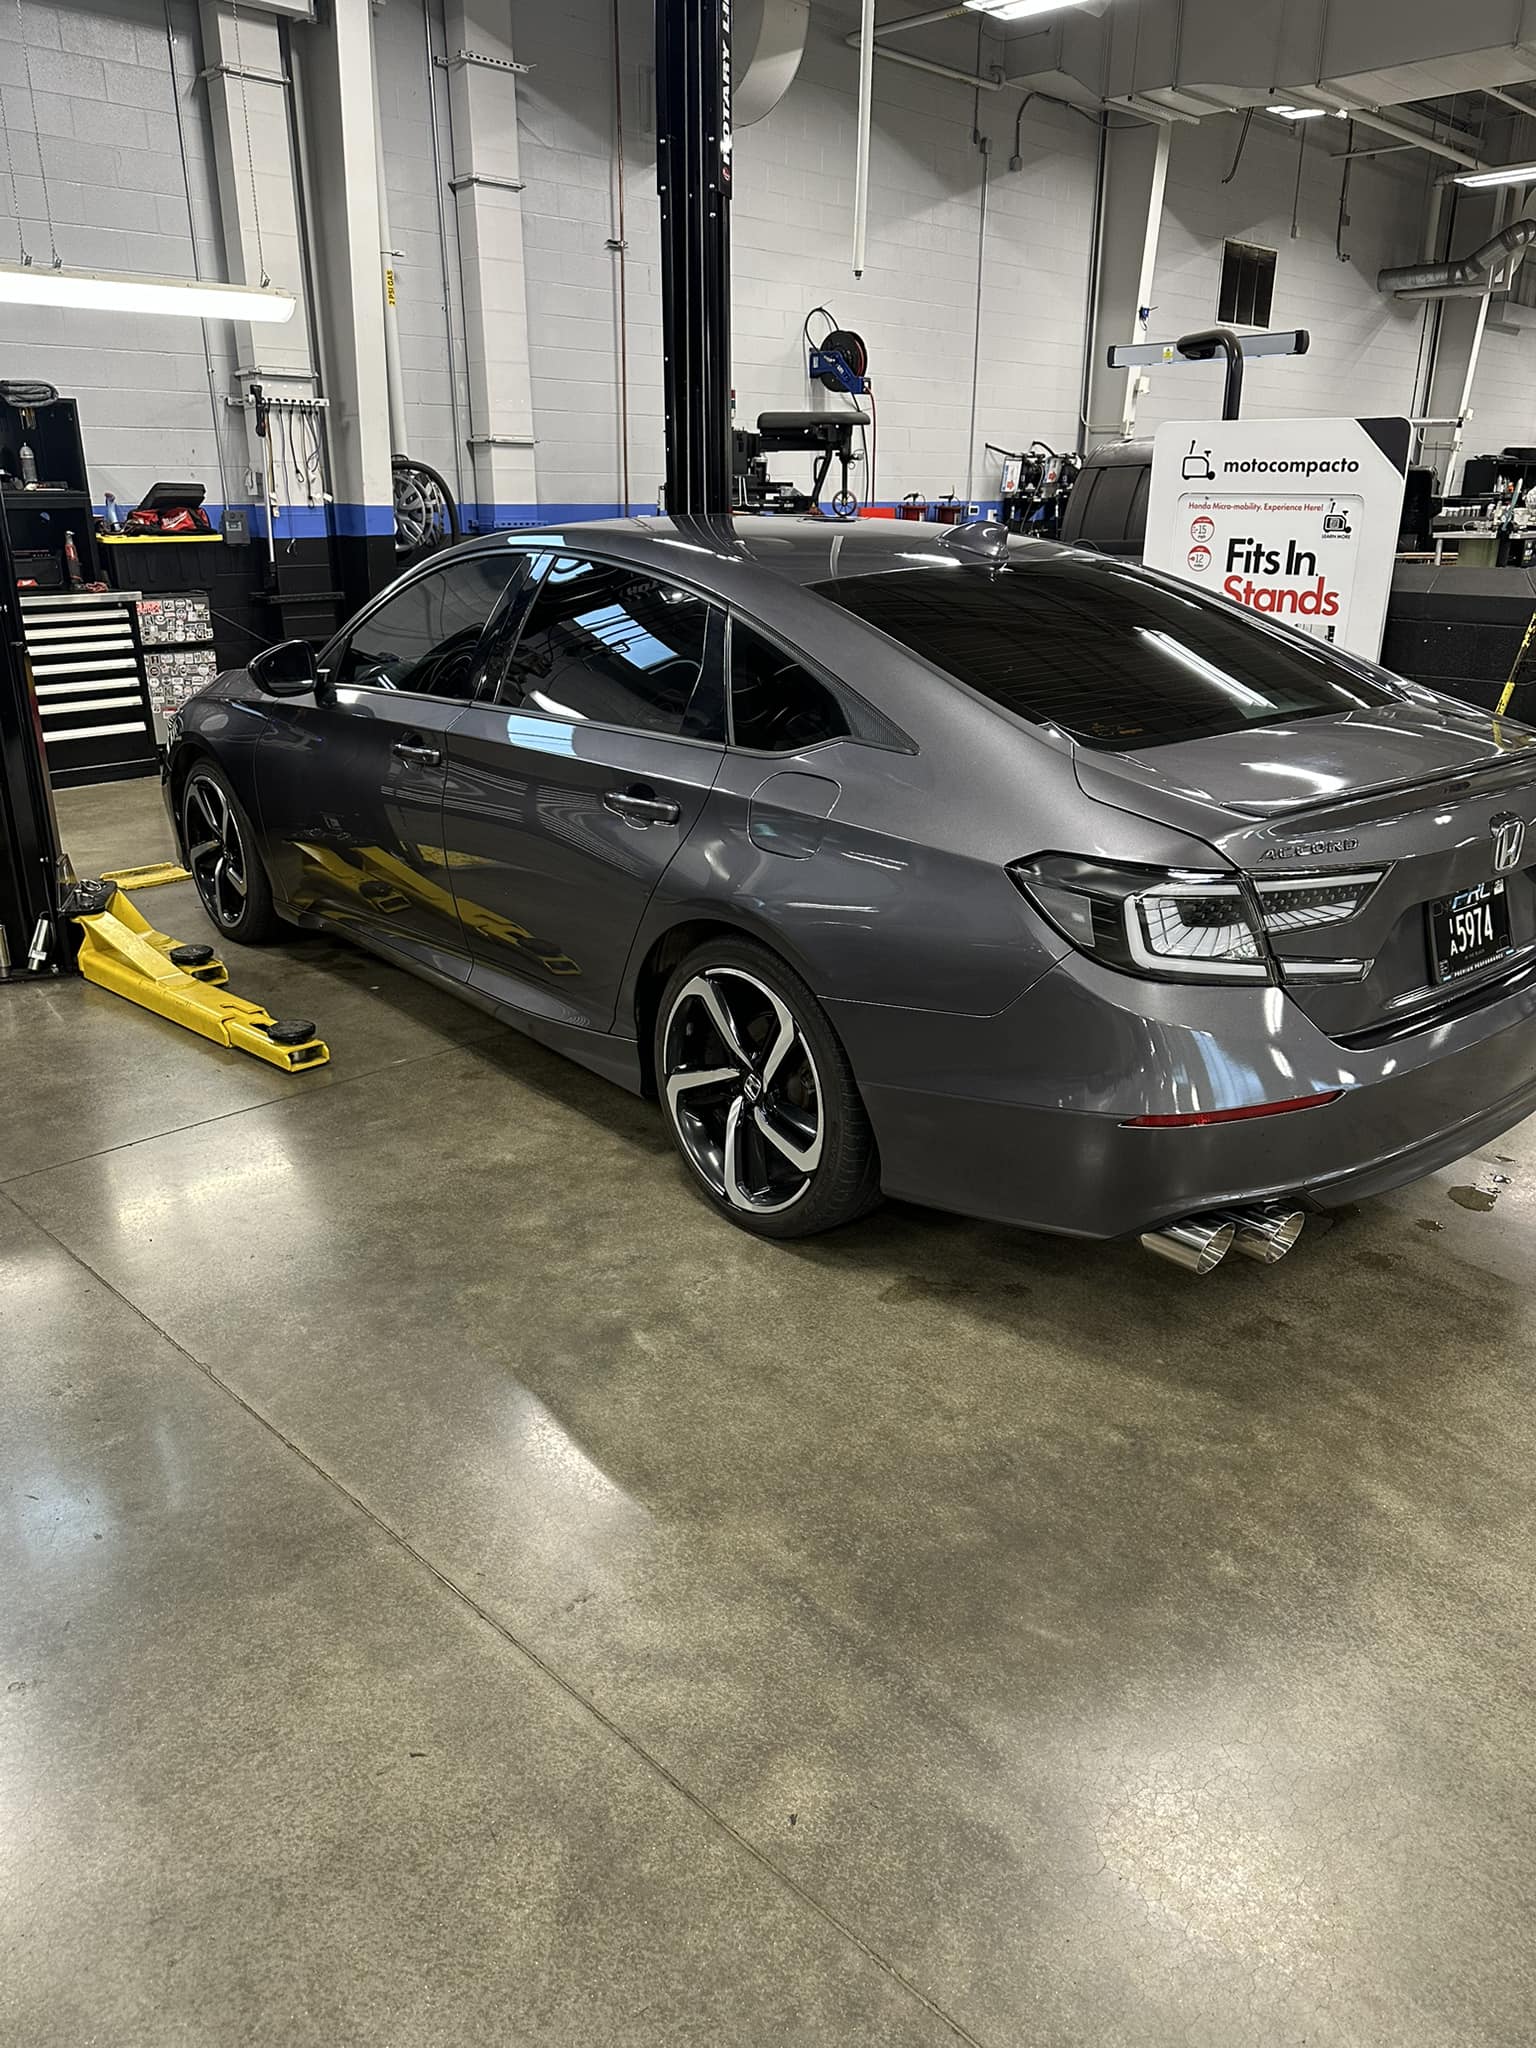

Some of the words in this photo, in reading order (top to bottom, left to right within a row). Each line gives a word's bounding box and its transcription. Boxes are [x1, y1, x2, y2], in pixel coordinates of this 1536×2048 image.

[1224, 458, 1359, 477] motocompacto
[1188, 502, 1211, 510] Honda
[1264, 503, 1302, 512] Experience
[1303, 503, 1324, 512] Here!
[1198, 524, 1207, 535] 15
[1195, 553, 1204, 563] 12
[1226, 537, 1281, 575] Fits
[1224, 575, 1339, 616] Stands
[1257, 838, 1360, 863] ACCORD
[1456, 904, 1494, 952] 5974
